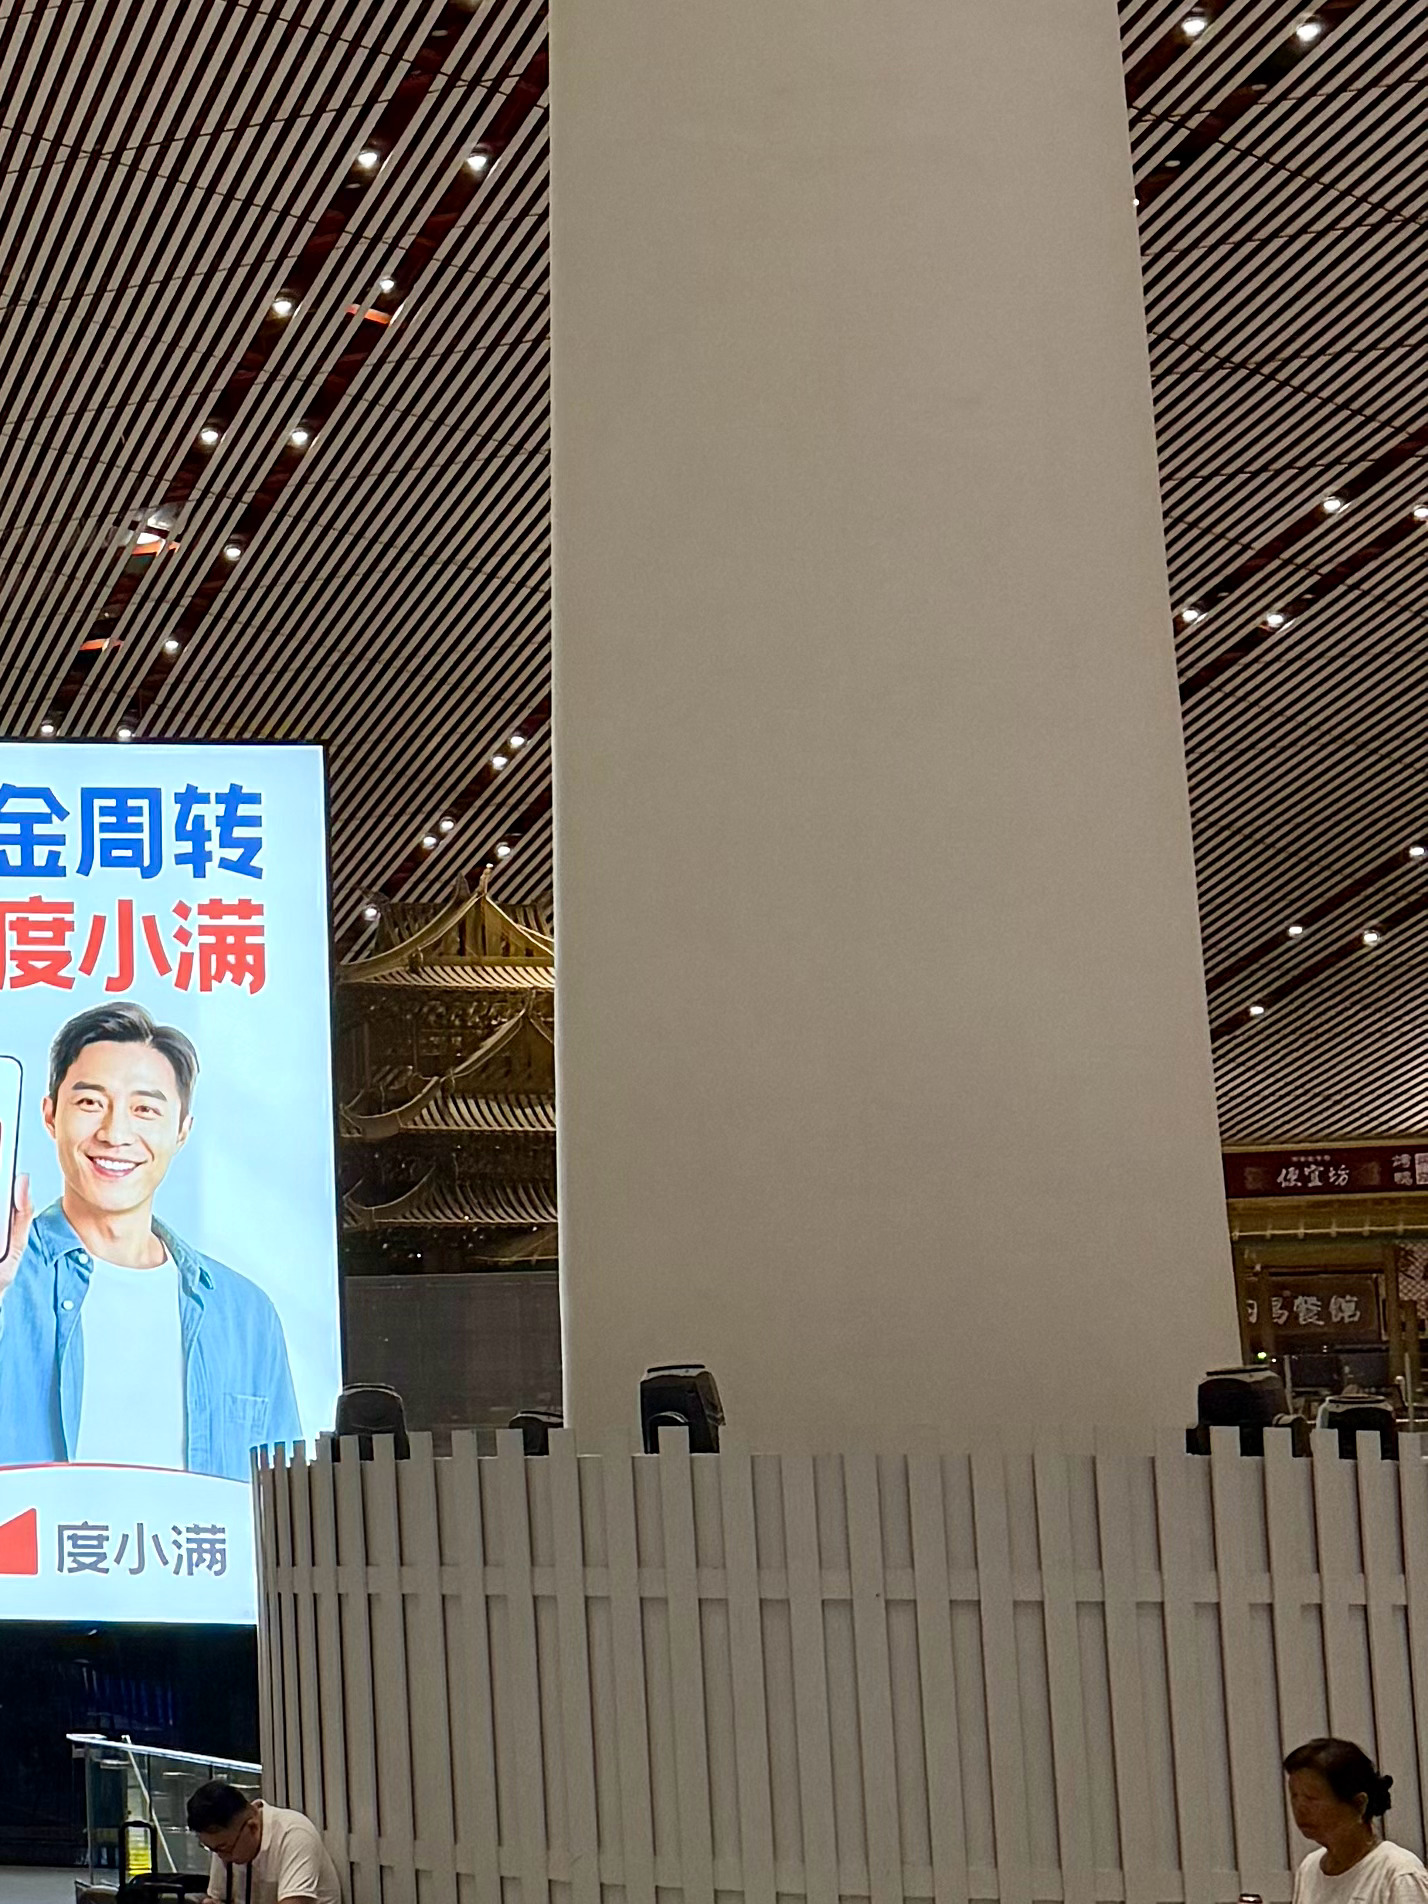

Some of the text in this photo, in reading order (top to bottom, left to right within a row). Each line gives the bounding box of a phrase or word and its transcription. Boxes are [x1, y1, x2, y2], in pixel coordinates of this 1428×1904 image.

[1277, 1165, 1350, 1188] 便宜坊
[57, 1521, 227, 1577] 度小满
